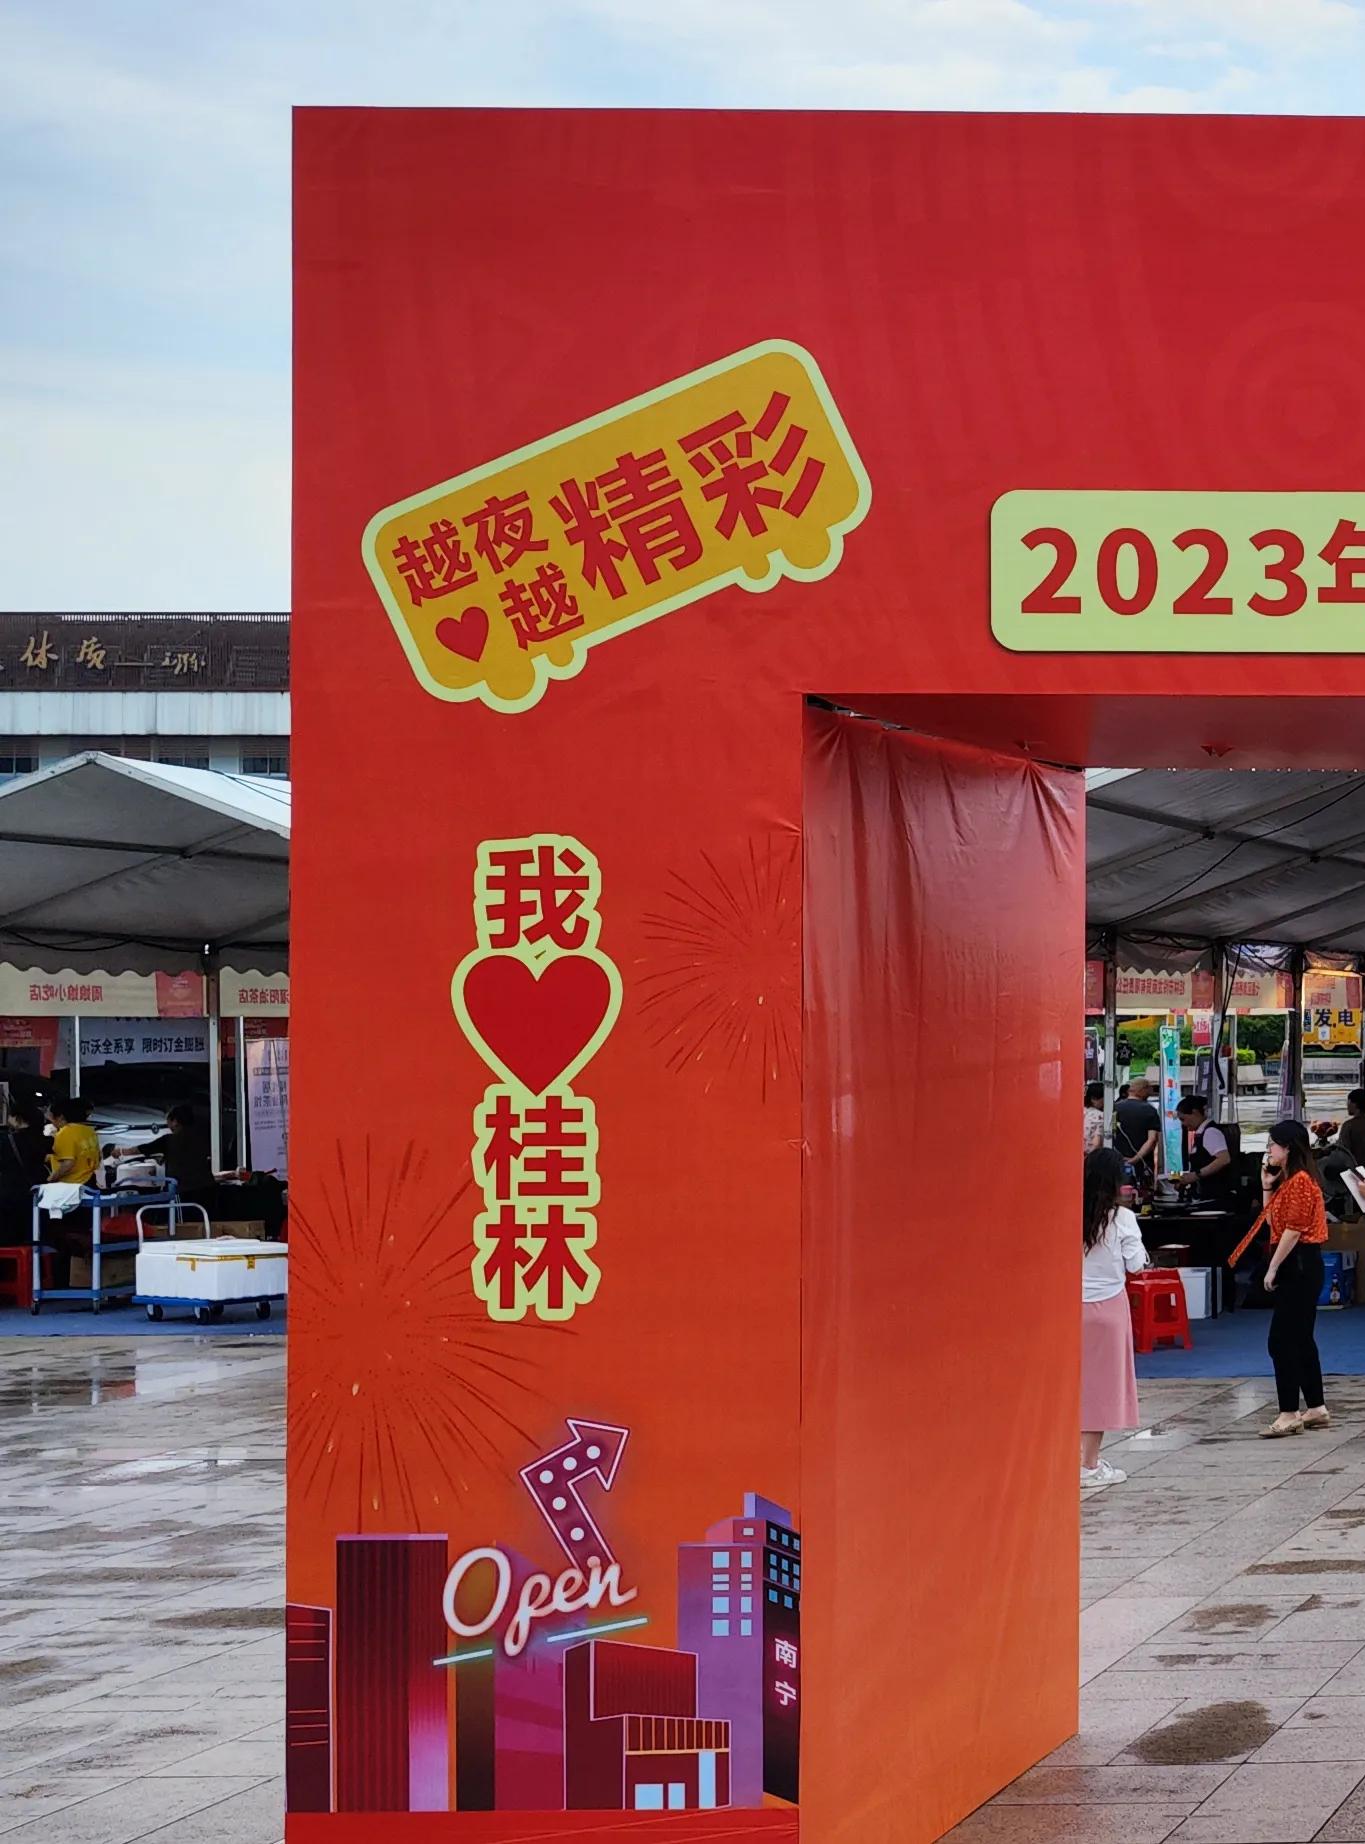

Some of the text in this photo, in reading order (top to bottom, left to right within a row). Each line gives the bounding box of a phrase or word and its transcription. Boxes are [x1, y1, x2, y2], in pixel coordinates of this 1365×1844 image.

[392, 491, 549, 607] 越夜
[547, 391, 826, 600] 精彩
[499, 562, 585, 651] 越
[483, 845, 590, 1309] 我 桂林
[442, 1546, 638, 1657] Open
[774, 1637, 798, 1706] 南宁
